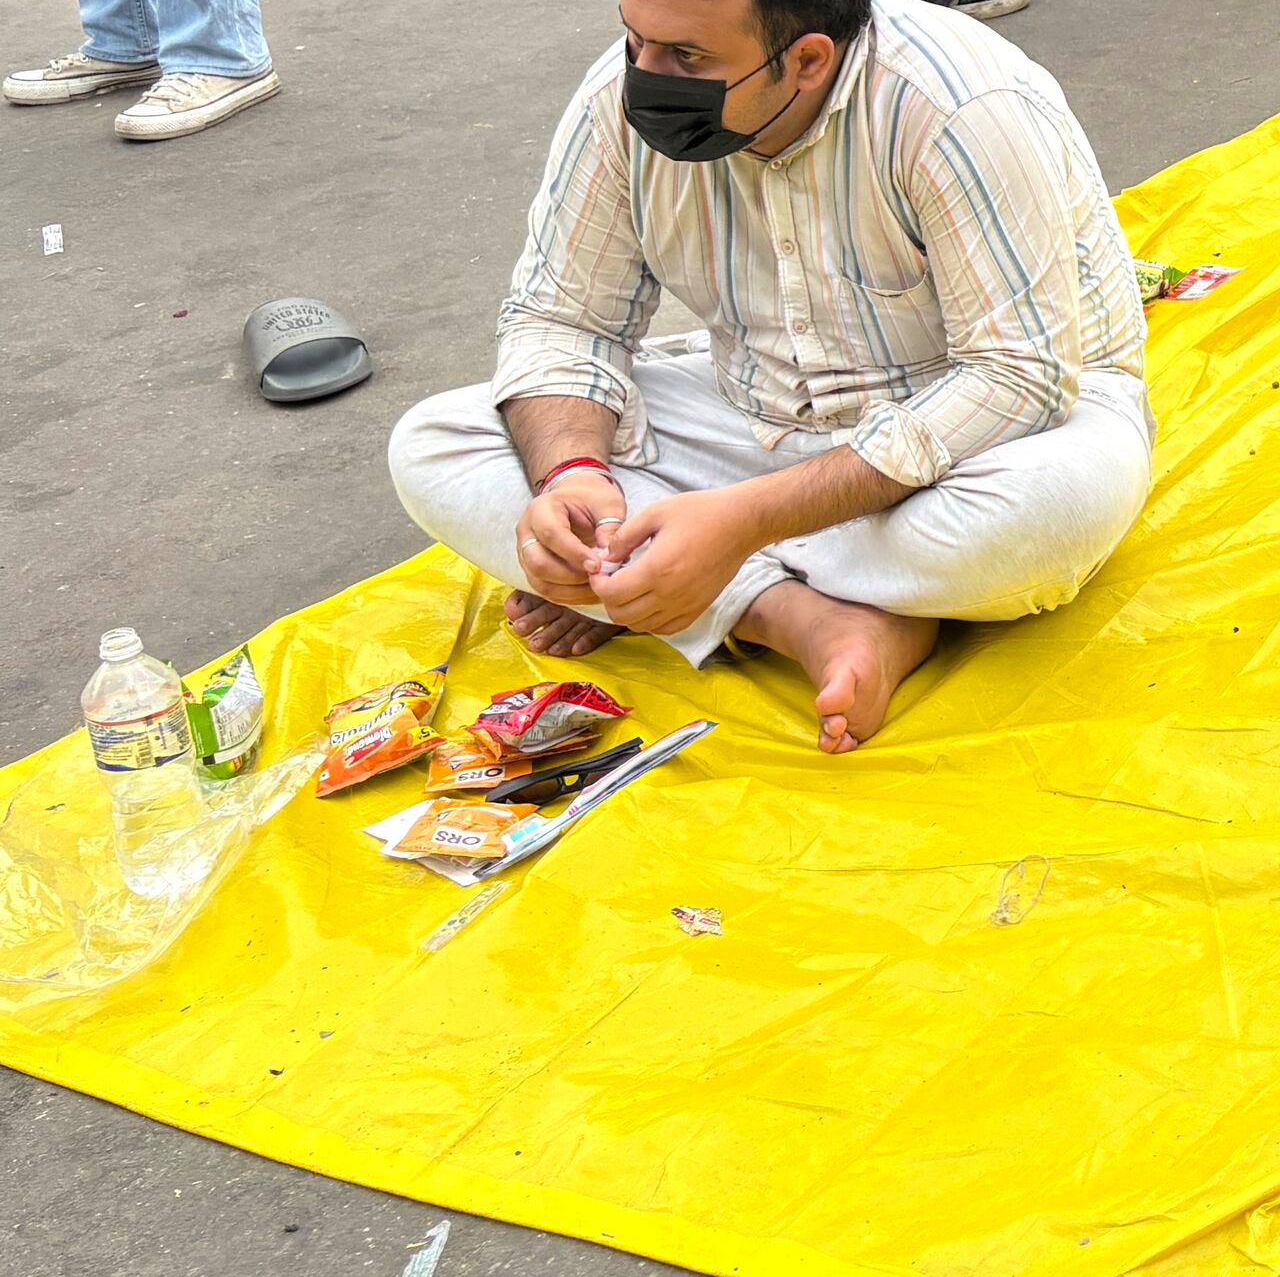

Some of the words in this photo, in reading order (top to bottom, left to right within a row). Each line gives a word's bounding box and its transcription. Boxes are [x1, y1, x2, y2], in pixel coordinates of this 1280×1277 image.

[344, 725, 392, 756] Diamond
[457, 767, 503, 782] ORS
[434, 829, 481, 846] ORS
